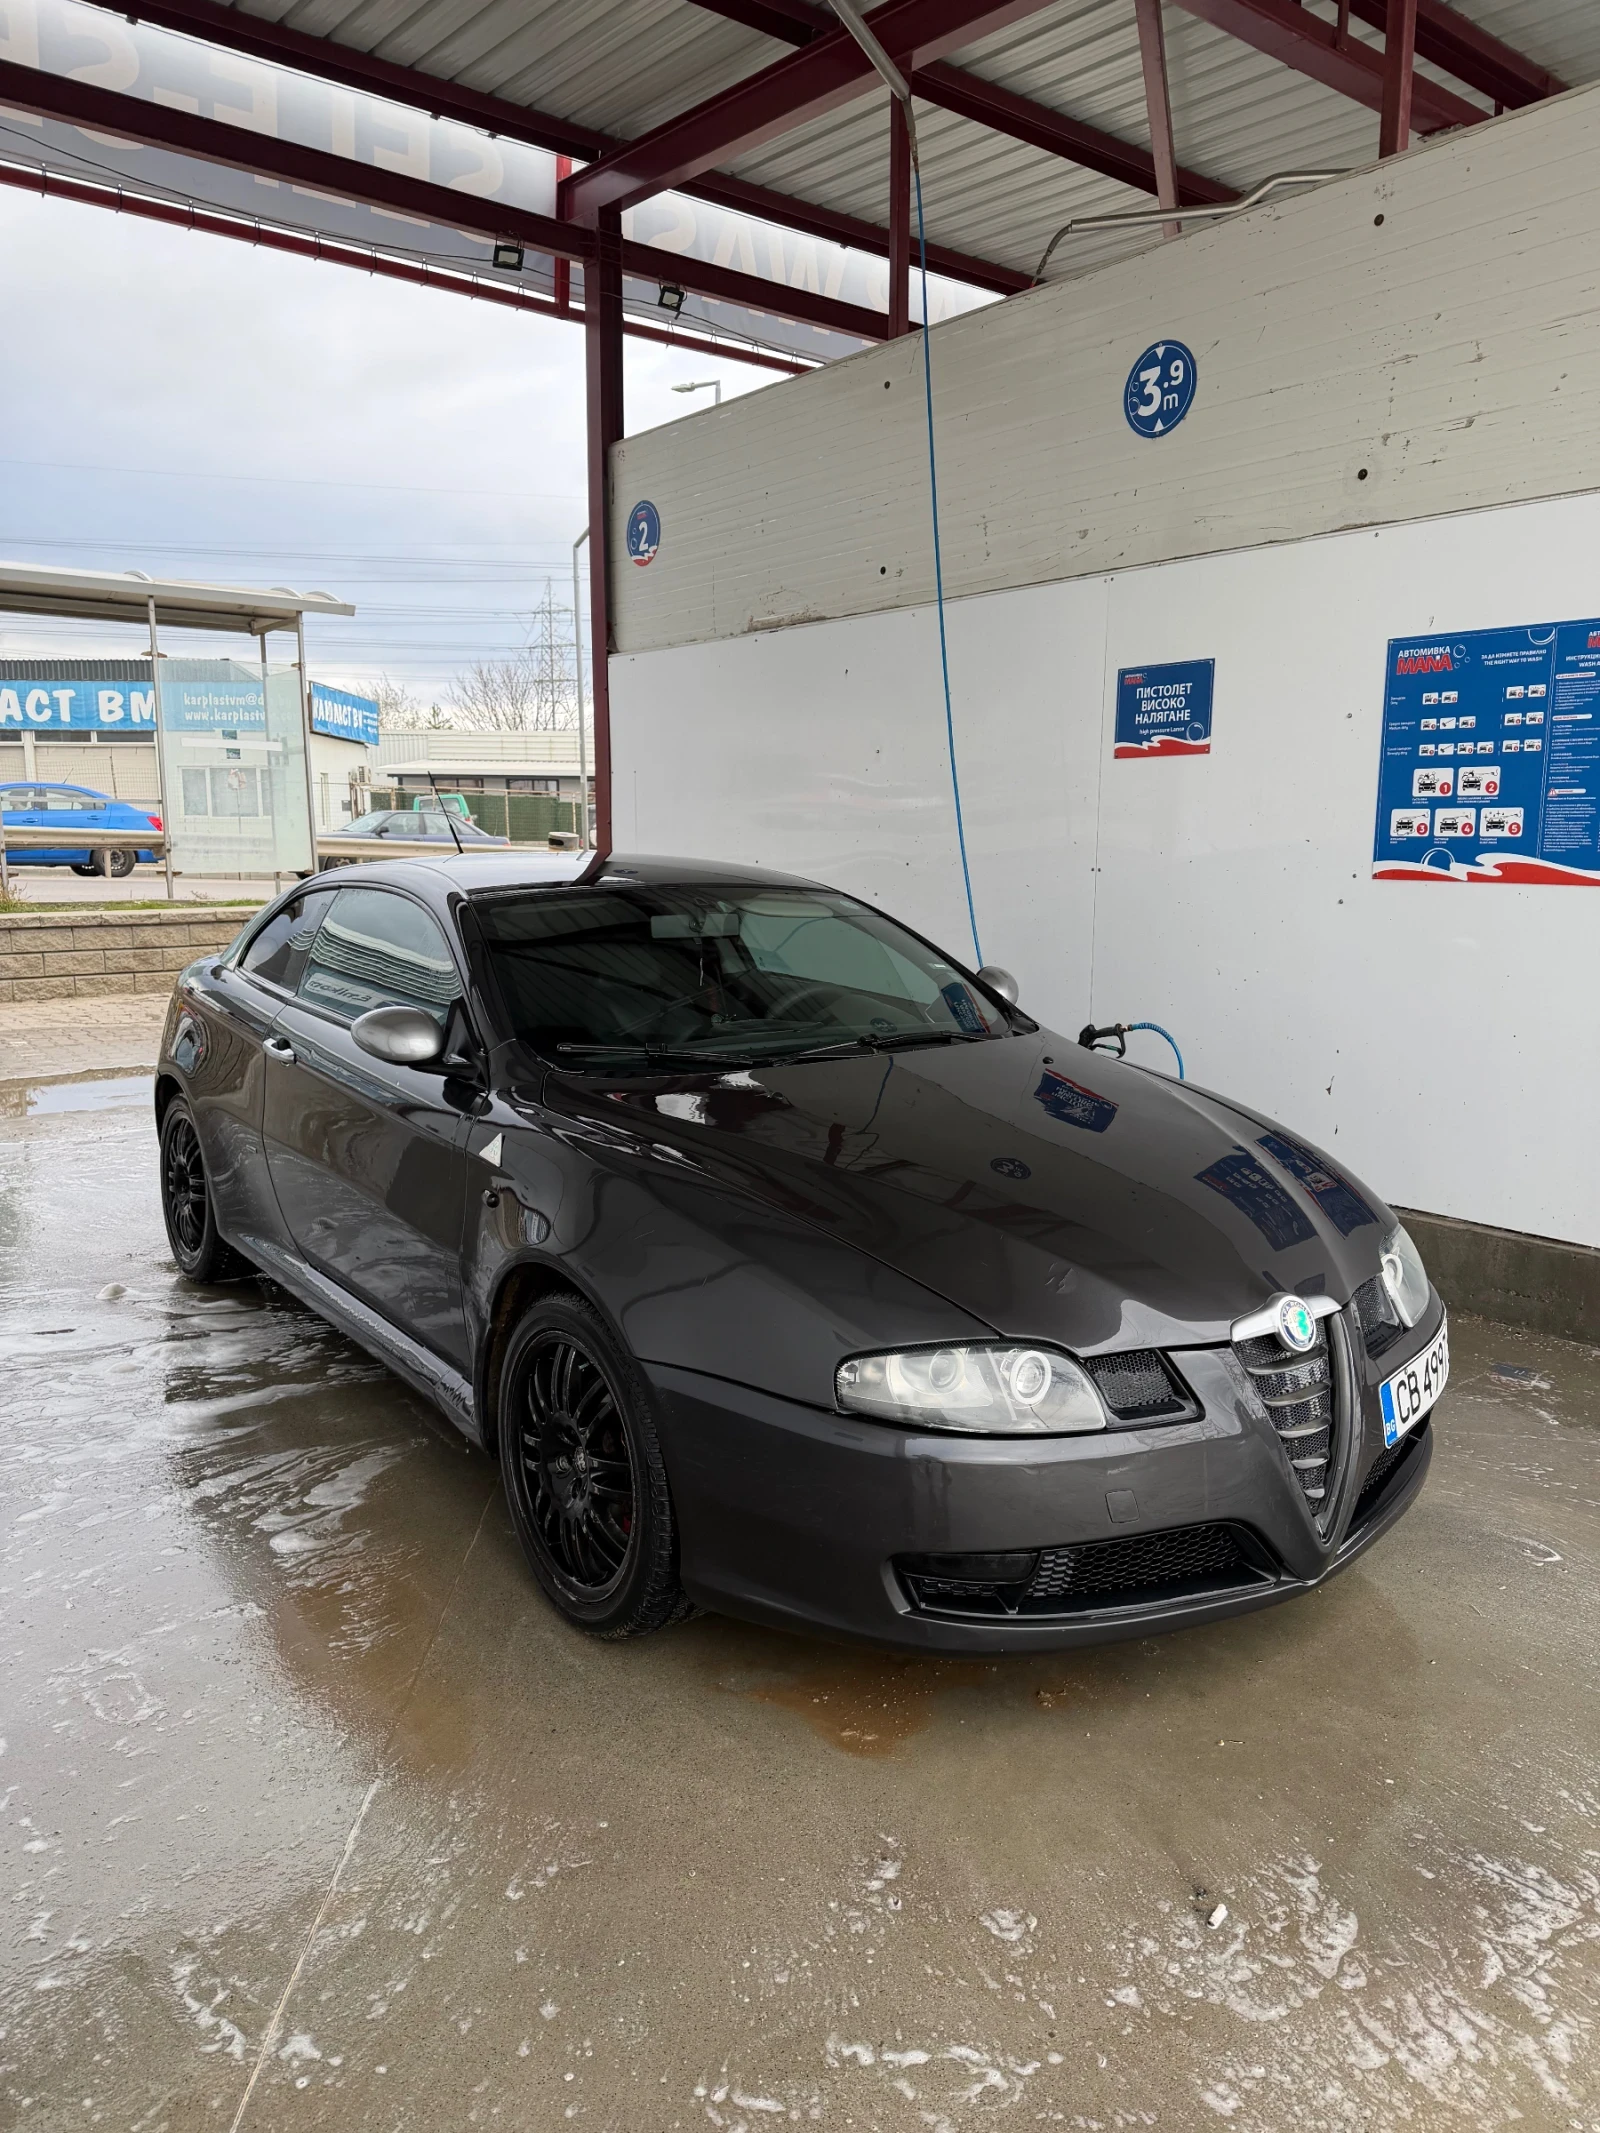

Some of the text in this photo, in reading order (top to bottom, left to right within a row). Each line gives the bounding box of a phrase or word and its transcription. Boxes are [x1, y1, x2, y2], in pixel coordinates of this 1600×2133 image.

[638, 521, 649, 552] 2
[1397, 646, 1451, 658] АВТОМИВКА
[1136, 682, 1193, 699] ПИСТОЛЕТ
[1141, 697, 1186, 711] ВИСОКО
[1135, 709, 1191, 725] НАЛЯГАНЕ
[1488, 783, 1495, 792] 2
[1419, 825, 1425, 833] 3
[1463, 824, 1471, 833] 4
[1511, 824, 1518, 833] 5
[1385, 1419, 1397, 1436] BG
